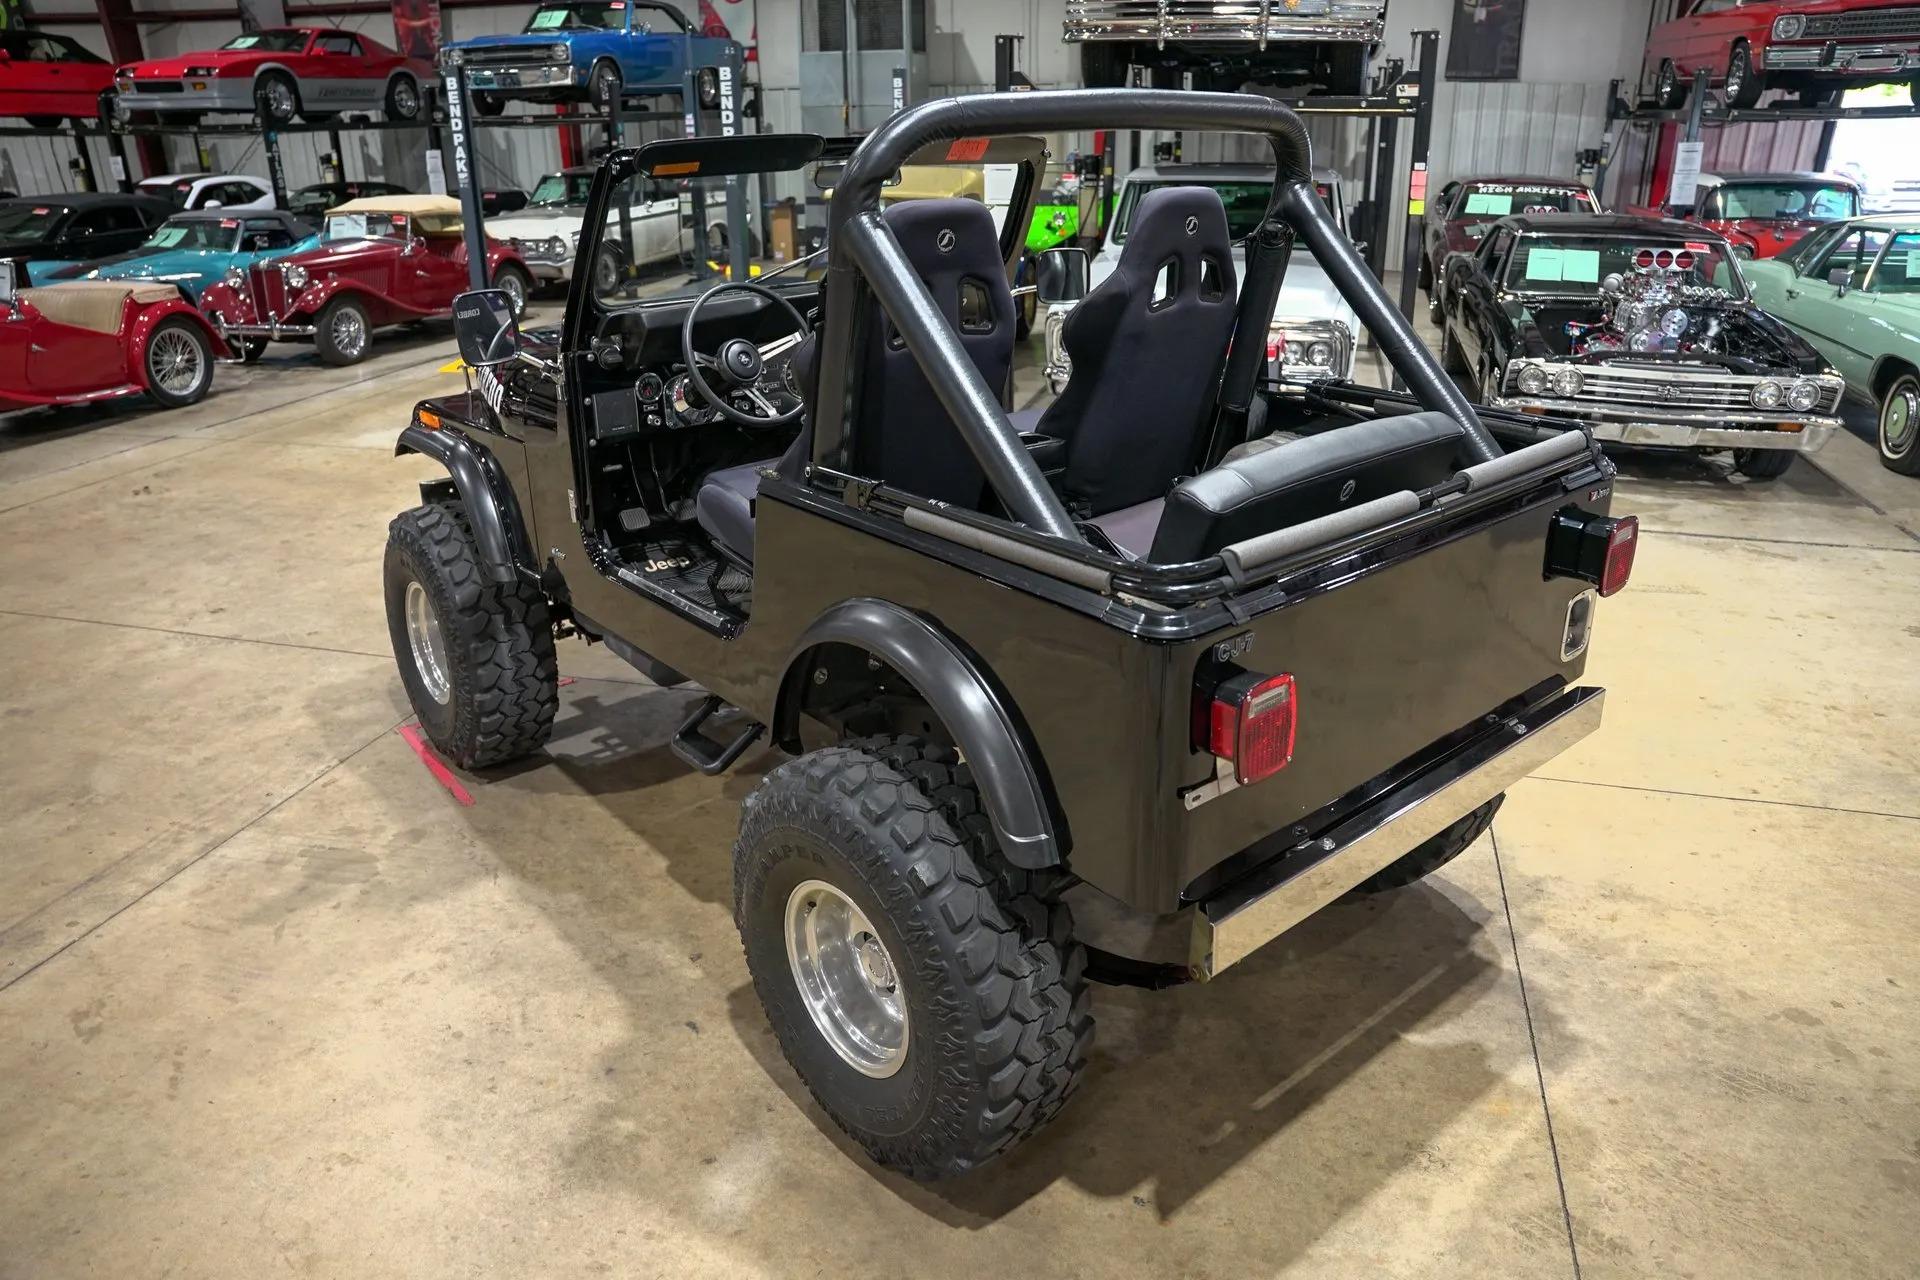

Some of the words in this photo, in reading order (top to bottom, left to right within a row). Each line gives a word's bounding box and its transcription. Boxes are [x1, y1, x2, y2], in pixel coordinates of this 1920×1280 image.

[717, 67, 735, 137] BENDP
[445, 77, 468, 172] BENDPAK
[272, 143, 286, 188] ATLAS
[1478, 186, 1513, 194] HIGH
[1516, 186, 1576, 197] ANXIETY
[644, 556, 690, 573] Jeep
[1217, 632, 1255, 663] CJ-7
